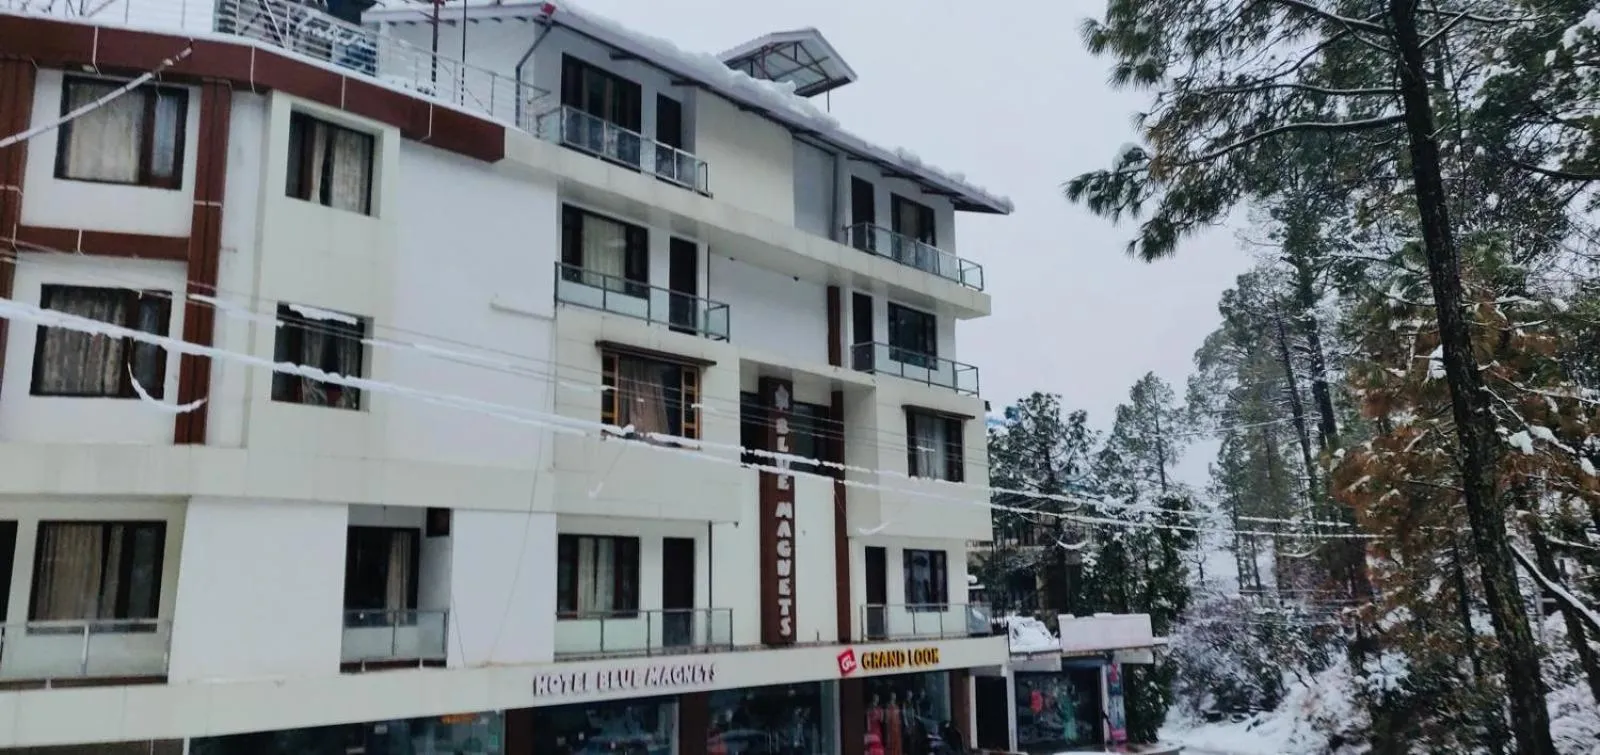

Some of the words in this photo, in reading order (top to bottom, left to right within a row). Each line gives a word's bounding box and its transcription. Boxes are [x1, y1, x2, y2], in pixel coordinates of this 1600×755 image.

[775, 501, 793, 637] MAGNETS
[861, 650, 906, 670] GRAND
[907, 647, 940, 667] LOOK
[532, 673, 589, 696] HOTEL
[596, 669, 640, 691] BLUE
[643, 662, 717, 686] MAGNETS
